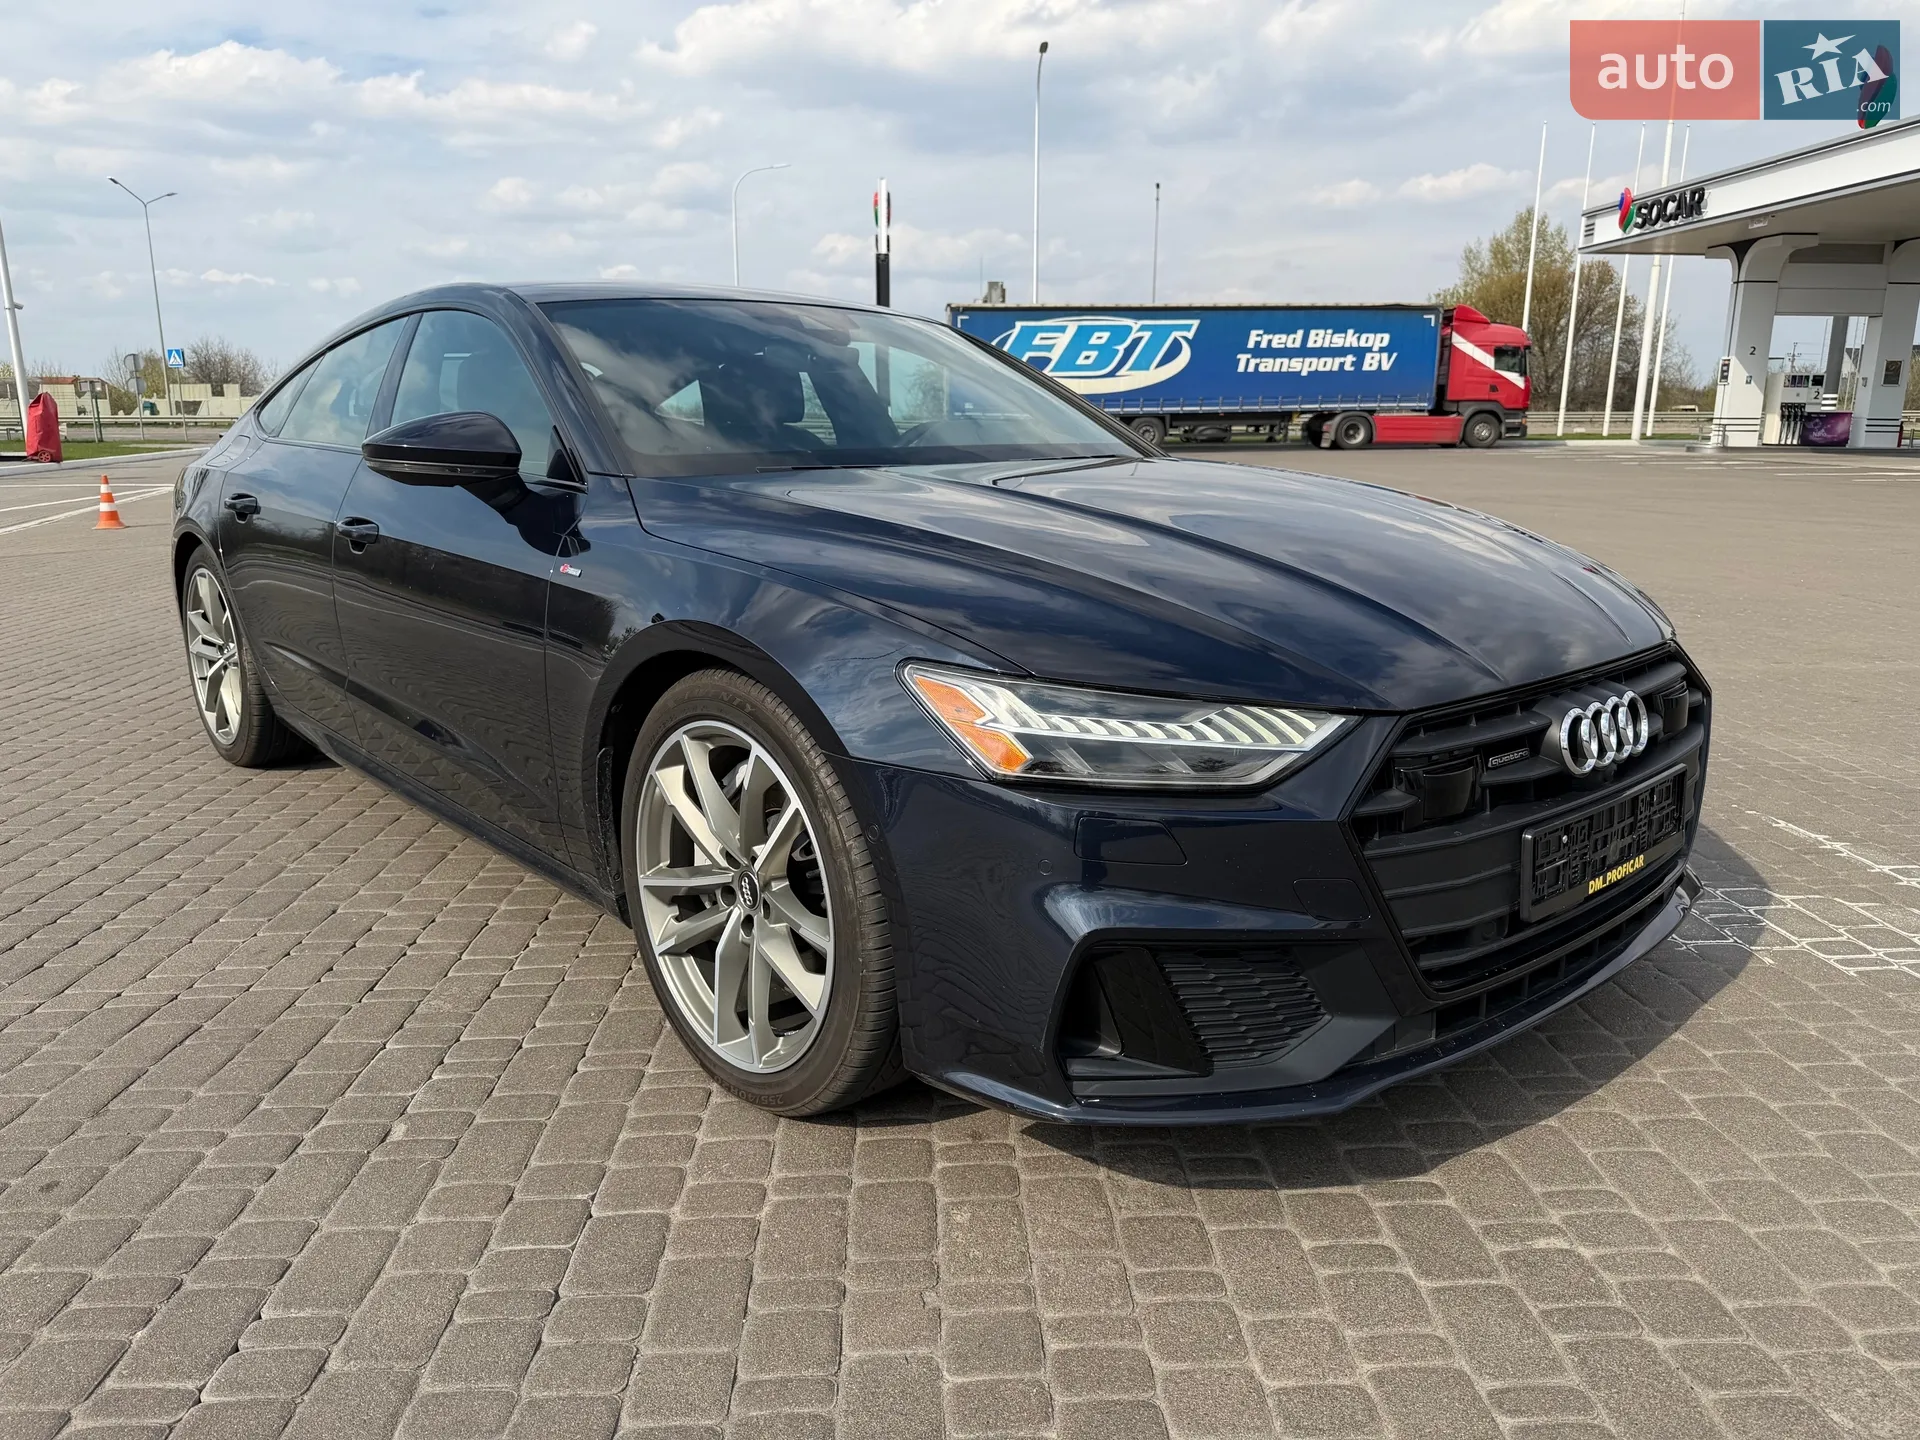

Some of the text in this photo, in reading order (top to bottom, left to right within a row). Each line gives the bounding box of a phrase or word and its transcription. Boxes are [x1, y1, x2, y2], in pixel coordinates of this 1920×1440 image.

[1633, 186, 1706, 230] SOCAR
[1246, 328, 1390, 352] Fred Biskop
[1749, 346, 1756, 355] 2
[1236, 351, 1399, 377] Transport BV
[1813, 390, 1820, 399] 2
[1491, 750, 1529, 766] quattro
[1588, 854, 1645, 895] DM_PROFICAR
